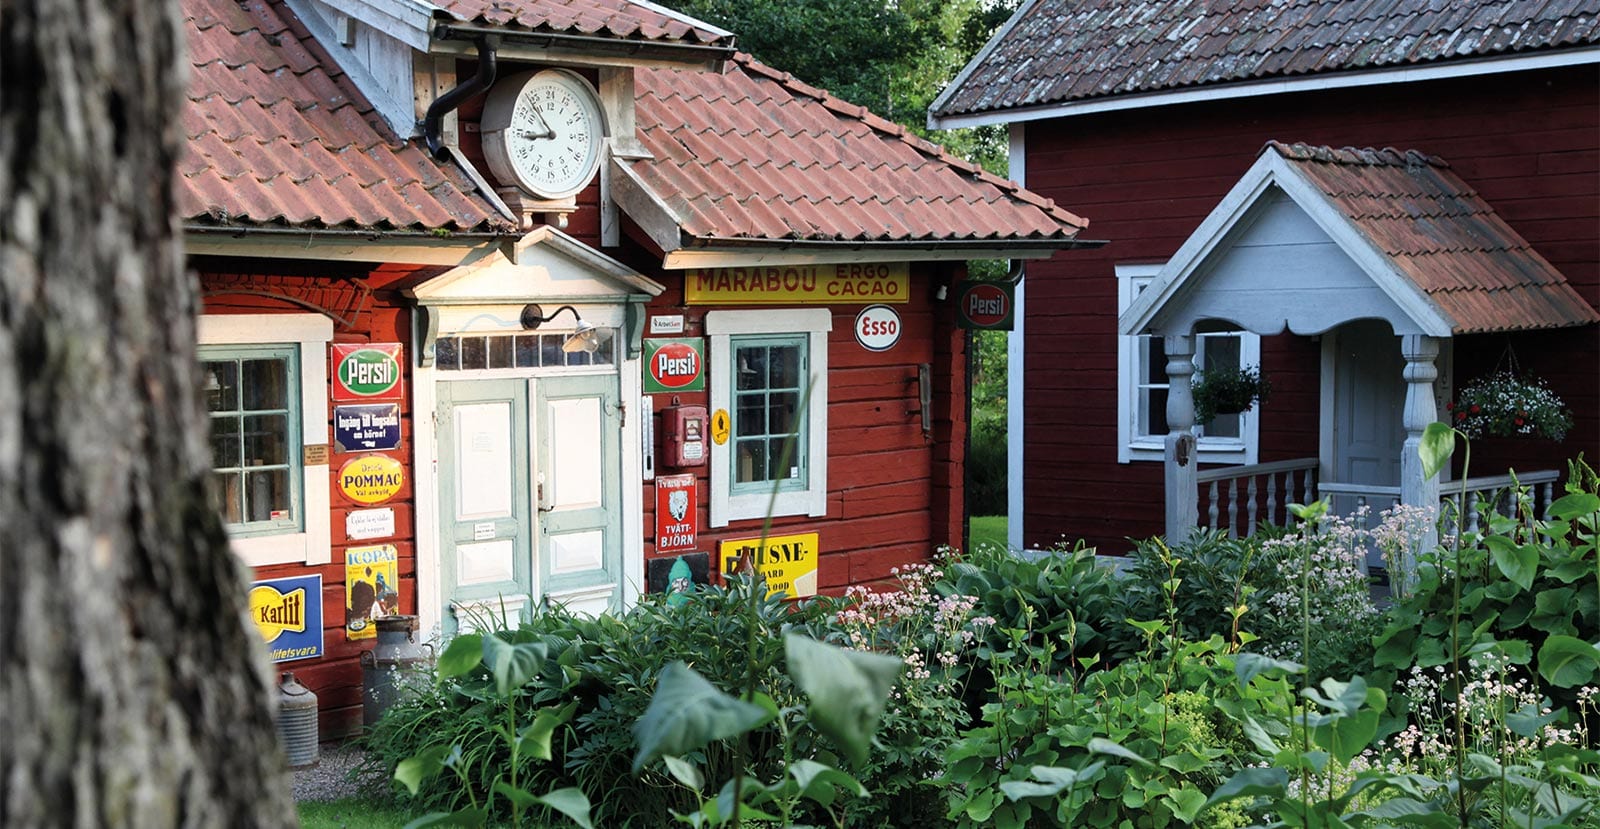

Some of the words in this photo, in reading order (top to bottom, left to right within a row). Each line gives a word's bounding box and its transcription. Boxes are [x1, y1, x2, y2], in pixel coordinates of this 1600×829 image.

[546, 90, 555, 100] 24
[546, 102, 555, 110] 12
[562, 97, 570, 106] 13
[519, 107, 529, 120] 22
[527, 114, 536, 125] 10
[573, 111, 582, 122] 14
[578, 133, 585, 142] 15
[519, 147, 528, 159] 20
[573, 152, 581, 162] 16
[530, 163, 540, 174] 19
[548, 160, 554, 168] 6
[547, 171, 555, 179] 18
[562, 165, 569, 176] 17
[836, 264, 889, 279] ERGO
[696, 267, 817, 292] MARABOU
[826, 281, 899, 296] CACAO
[969, 294, 1004, 316] Persil
[862, 316, 896, 336] Esso
[658, 352, 696, 378] Persil
[347, 358, 392, 385] Persil
[344, 473, 401, 489] POMMAC
[665, 523, 692, 534] TVÄTT-
[661, 534, 693, 548] BJÖRN
[736, 542, 808, 565] JUSNE-
[260, 594, 300, 625] Karlit
